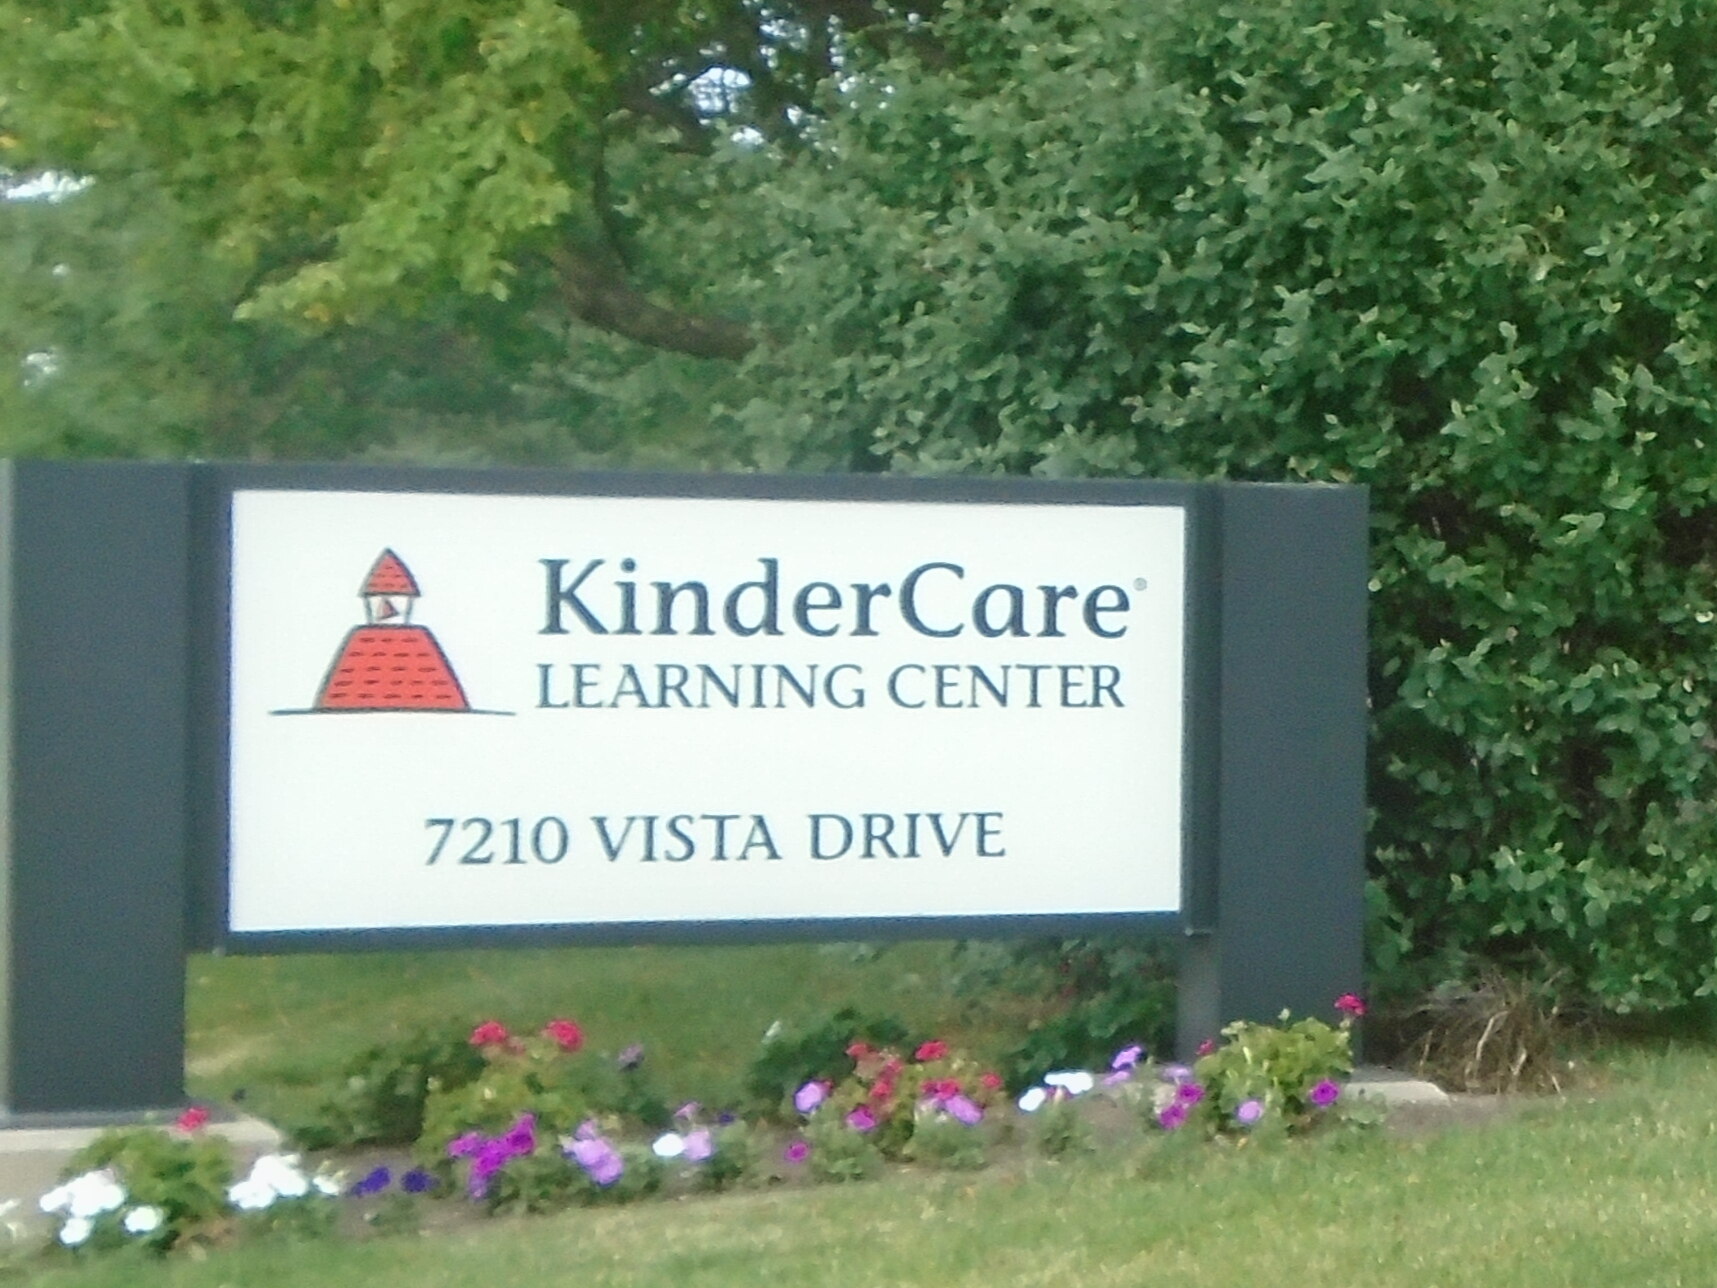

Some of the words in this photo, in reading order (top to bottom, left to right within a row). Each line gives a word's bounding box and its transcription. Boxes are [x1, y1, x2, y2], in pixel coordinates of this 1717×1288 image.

[537, 557, 1133, 640] KinderCare
[536, 662, 866, 710] LEARNING
[885, 664, 1127, 710] CENTER
[424, 816, 570, 867] 7210
[590, 814, 783, 863] VISTA
[808, 811, 1007, 861] DRIVE
